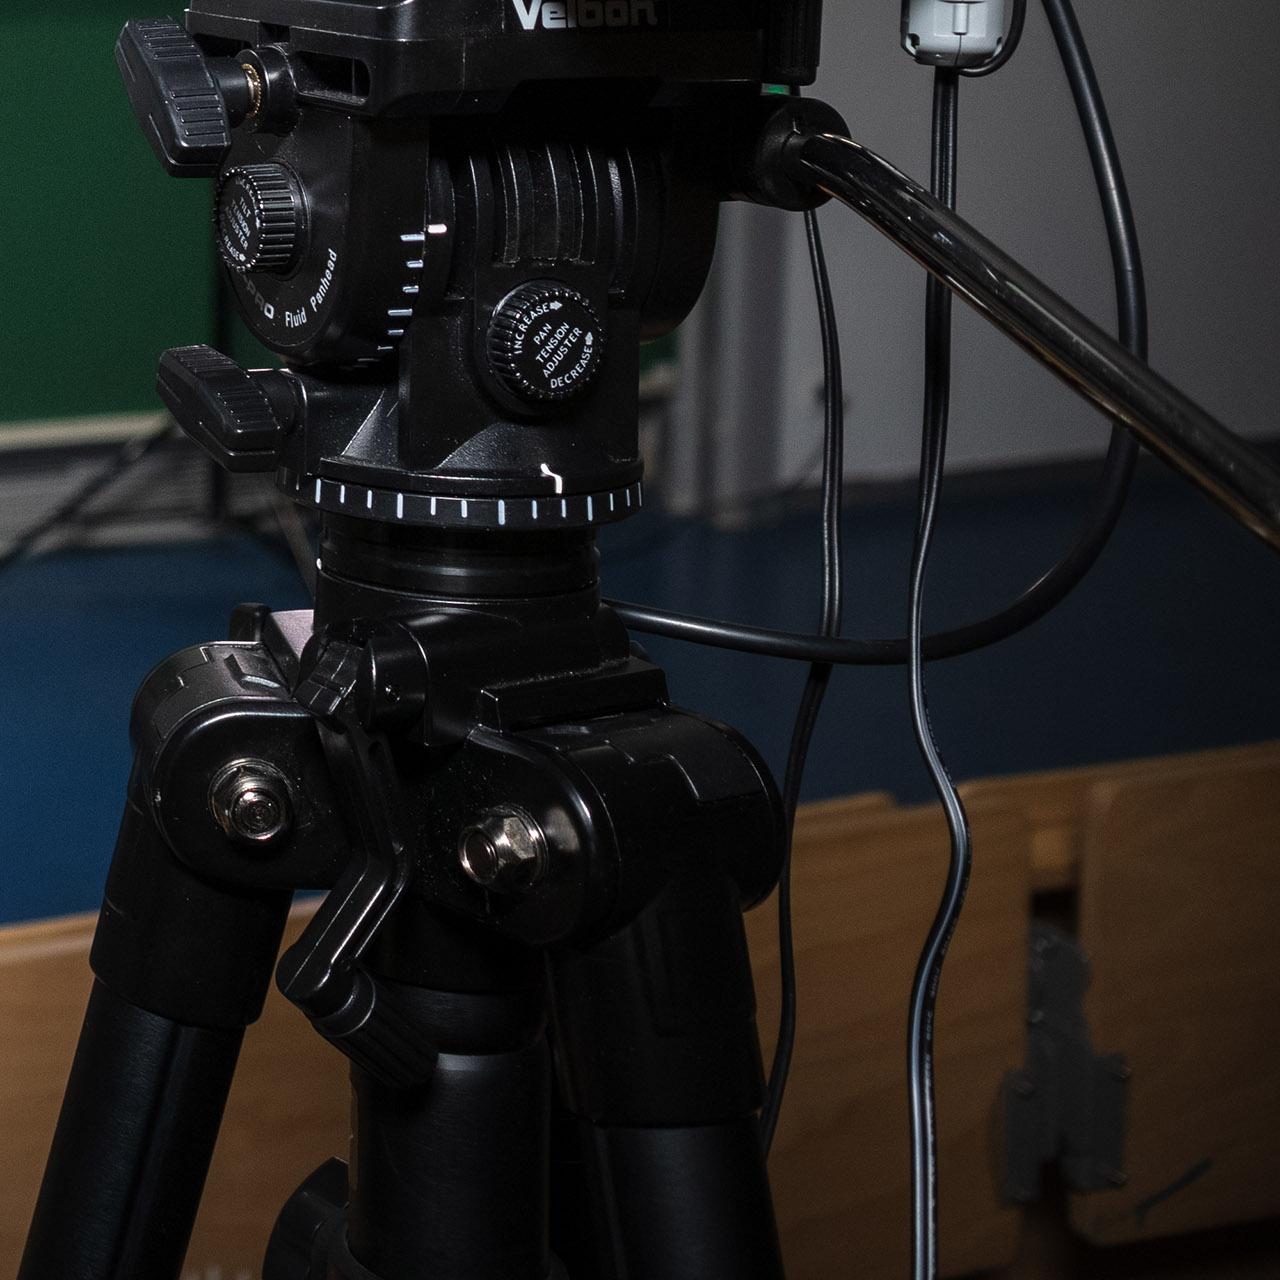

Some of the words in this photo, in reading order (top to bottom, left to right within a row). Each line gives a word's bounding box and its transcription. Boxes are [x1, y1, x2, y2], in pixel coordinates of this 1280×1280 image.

[239, 196, 251, 218] TILT
[285, 307, 308, 328] Fluid
[310, 248, 338, 312] Panhead
[514, 302, 550, 354] INCREASE
[533, 323, 552, 345] PAN
[535, 322, 570, 363] TENSION
[543, 327, 582, 378] ADJUSTER
[550, 345, 593, 389] DECREASE
